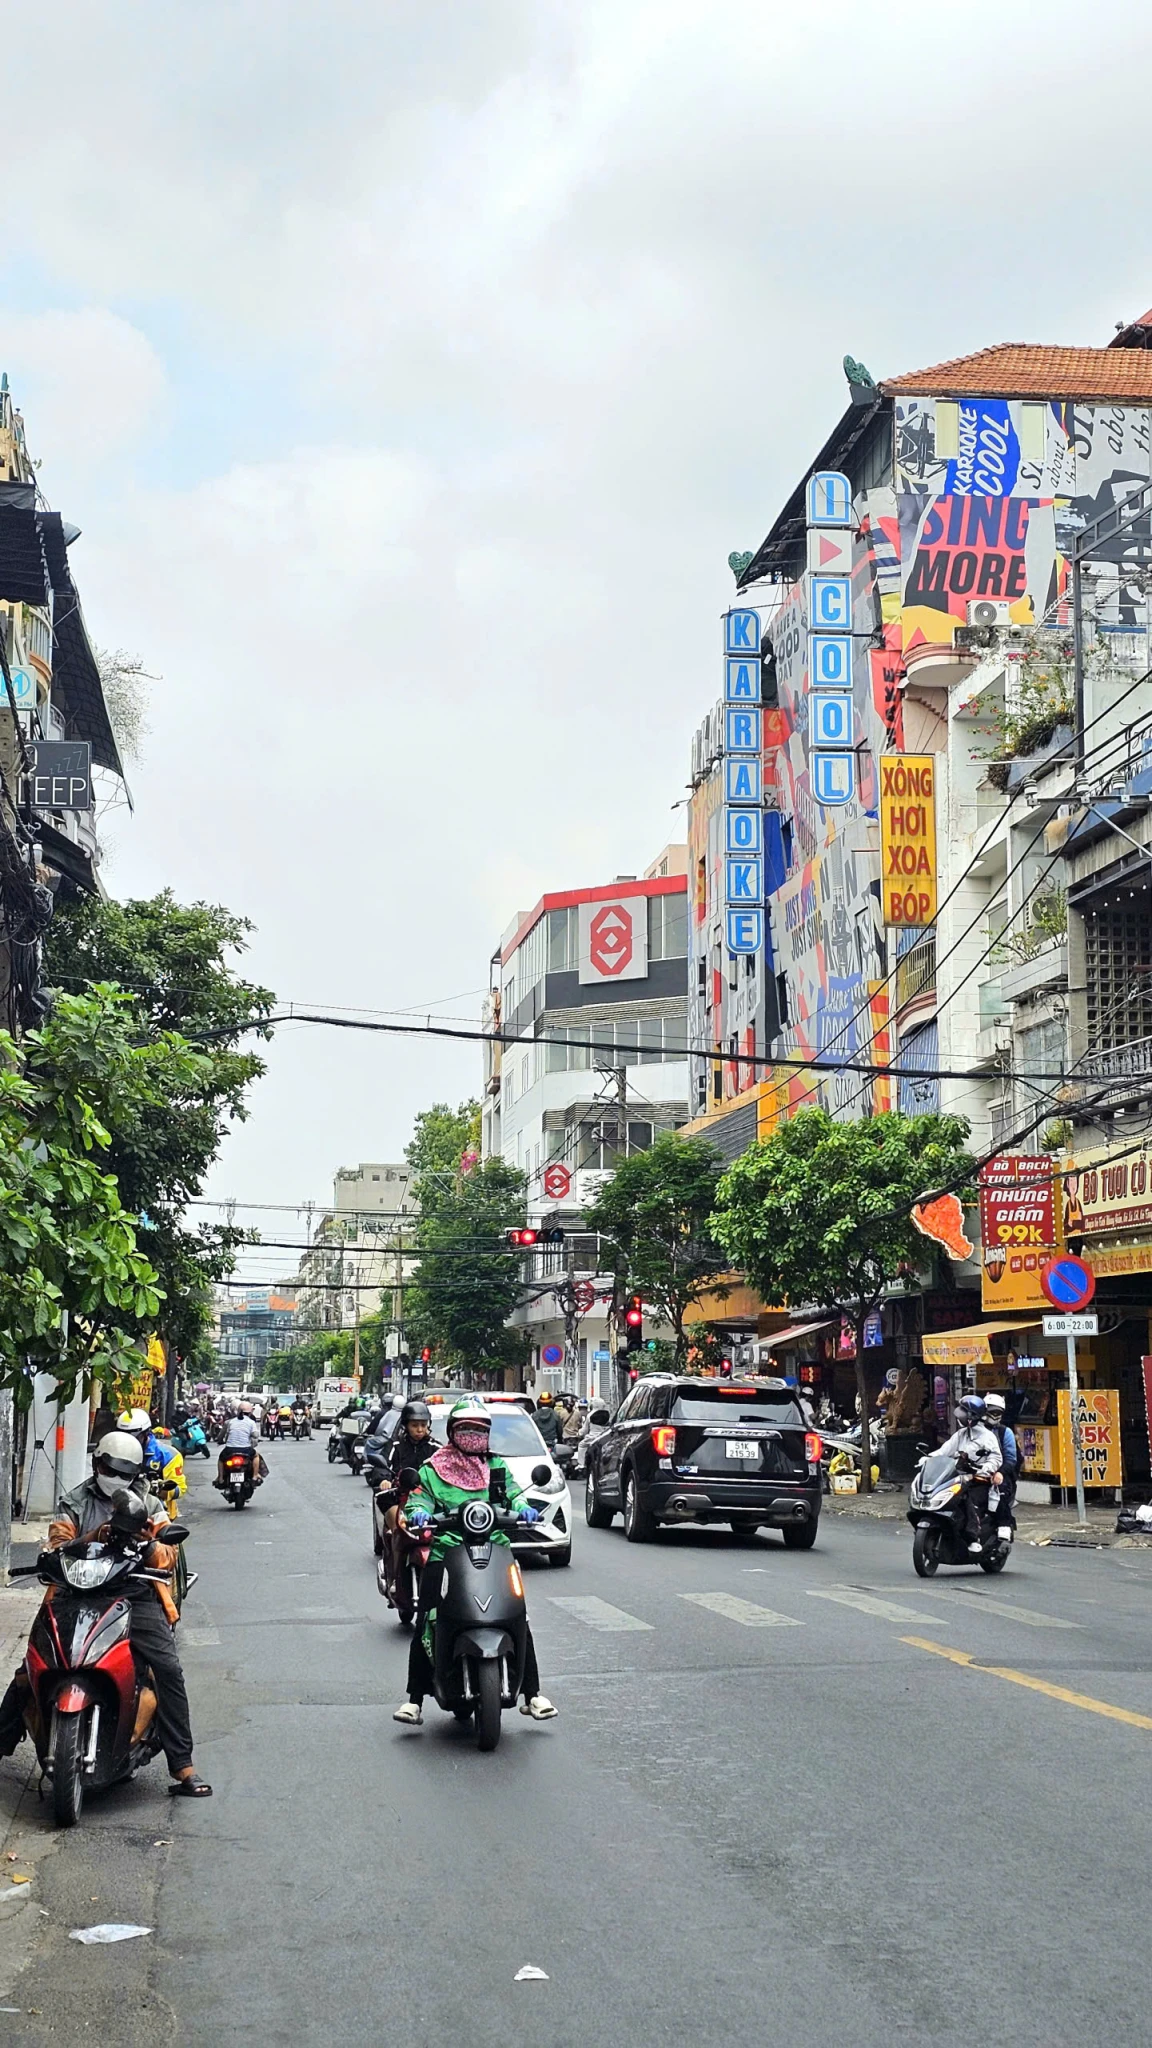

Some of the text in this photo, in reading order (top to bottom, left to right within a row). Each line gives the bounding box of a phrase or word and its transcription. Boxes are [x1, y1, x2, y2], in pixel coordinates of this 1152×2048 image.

[953, 405, 977, 496] KARAOKE
[918, 498, 1033, 551] SING
[913, 549, 1028, 598] MORE
[732, 613, 755, 949] KARAOKE
[882, 758, 933, 798] XÔNG
[890, 803, 928, 837] HƠI
[888, 845, 932, 876] XOA
[890, 884, 931, 923] BÓP
[324, 1382, 354, 1393] FedEx
[729, 1449, 756, 1458] 215.39
[734, 1442, 750, 1450] 51K
